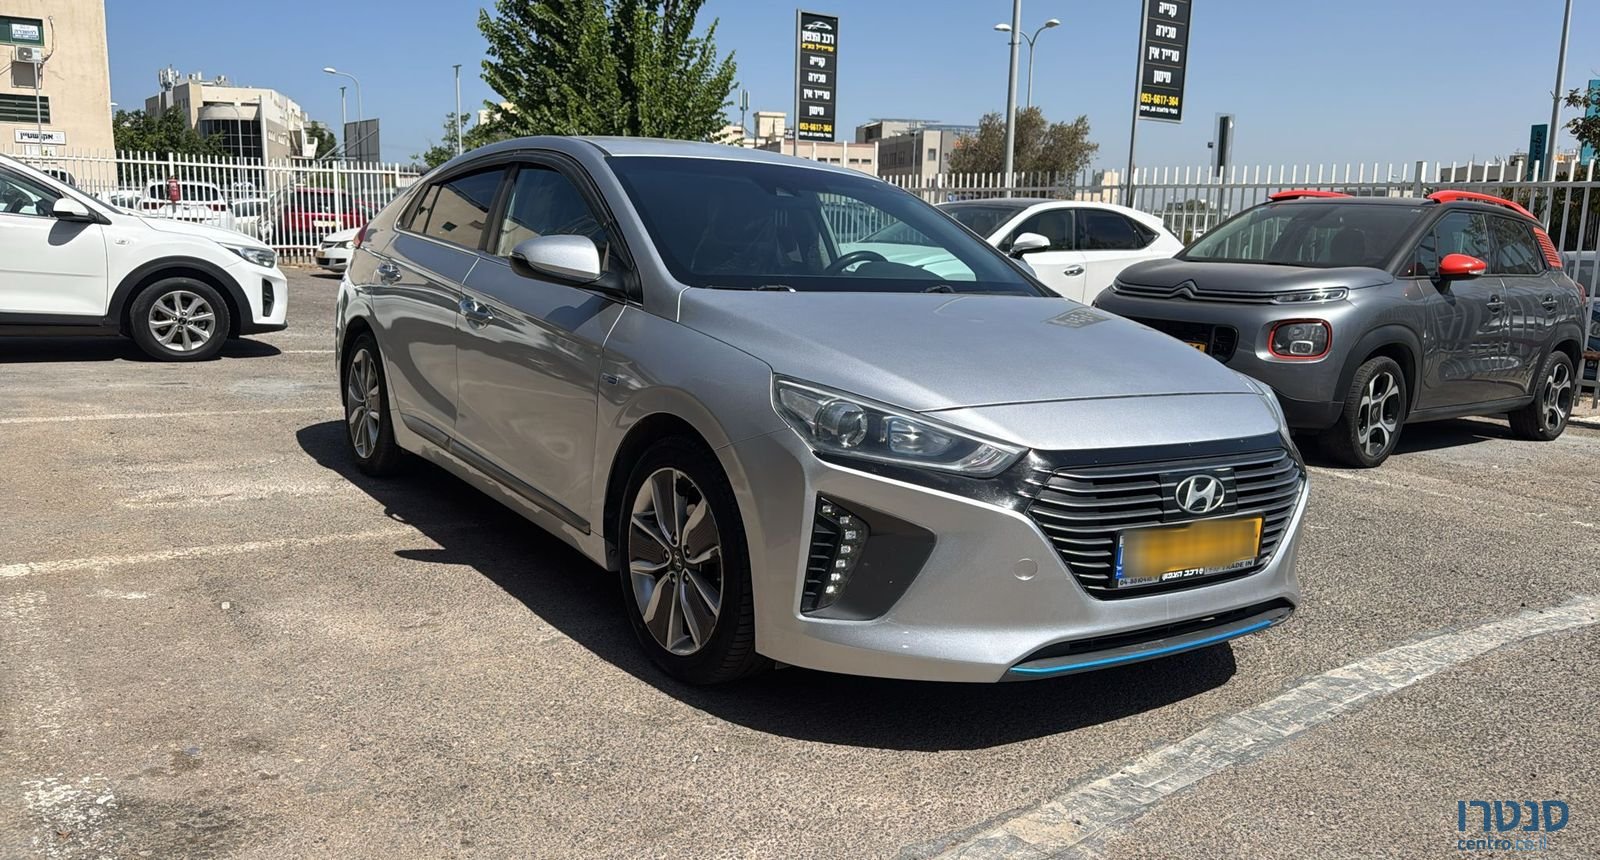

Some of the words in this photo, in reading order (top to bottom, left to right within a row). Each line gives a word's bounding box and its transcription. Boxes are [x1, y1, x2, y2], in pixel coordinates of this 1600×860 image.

[1158, 2, 1177, 18] קנייה
[1156, 24, 1176, 39] מכירה
[822, 33, 834, 44] רכב
[1149, 46, 1160, 60] אין
[1161, 48, 1179, 62] טרייד
[810, 56, 826, 68] קנייה
[808, 72, 826, 83] מכירה
[1153, 70, 1171, 84] מימון
[804, 88, 813, 99] אין
[815, 90, 830, 100] טרייד
[1141, 93, 1179, 106] 053-6617-364
[809, 106, 824, 116] מימון
[20, 132, 53, 140] אקשטיין
